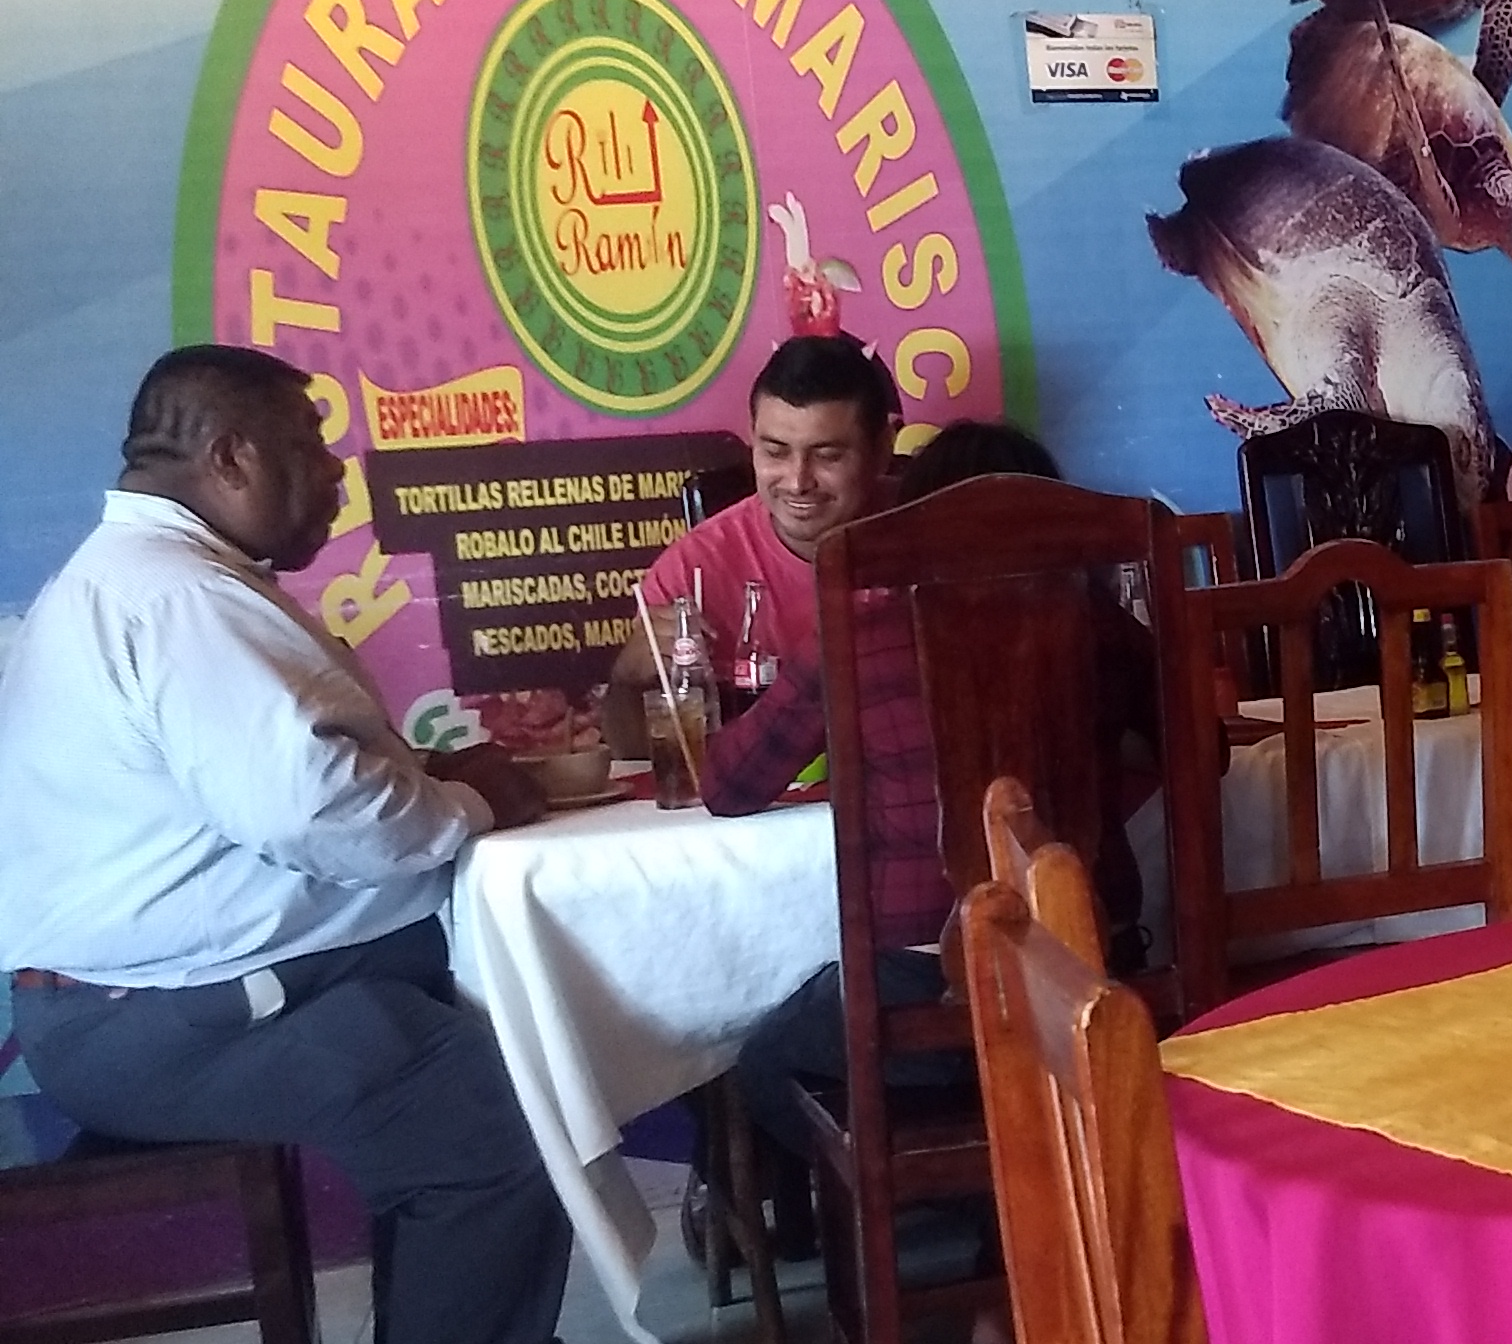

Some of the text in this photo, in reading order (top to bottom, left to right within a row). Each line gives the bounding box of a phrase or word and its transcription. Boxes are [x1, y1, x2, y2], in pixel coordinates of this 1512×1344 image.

[1047, 62, 1088, 78] VISA
[394, 470, 691, 515] TORTILLAS RELLENAS DE MARI
[456, 513, 687, 560] ROBALO AL CHILE LIMÓN
[461, 572, 593, 609] MARISCADAS,
[473, 618, 636, 657] PESCADOS, MARI
